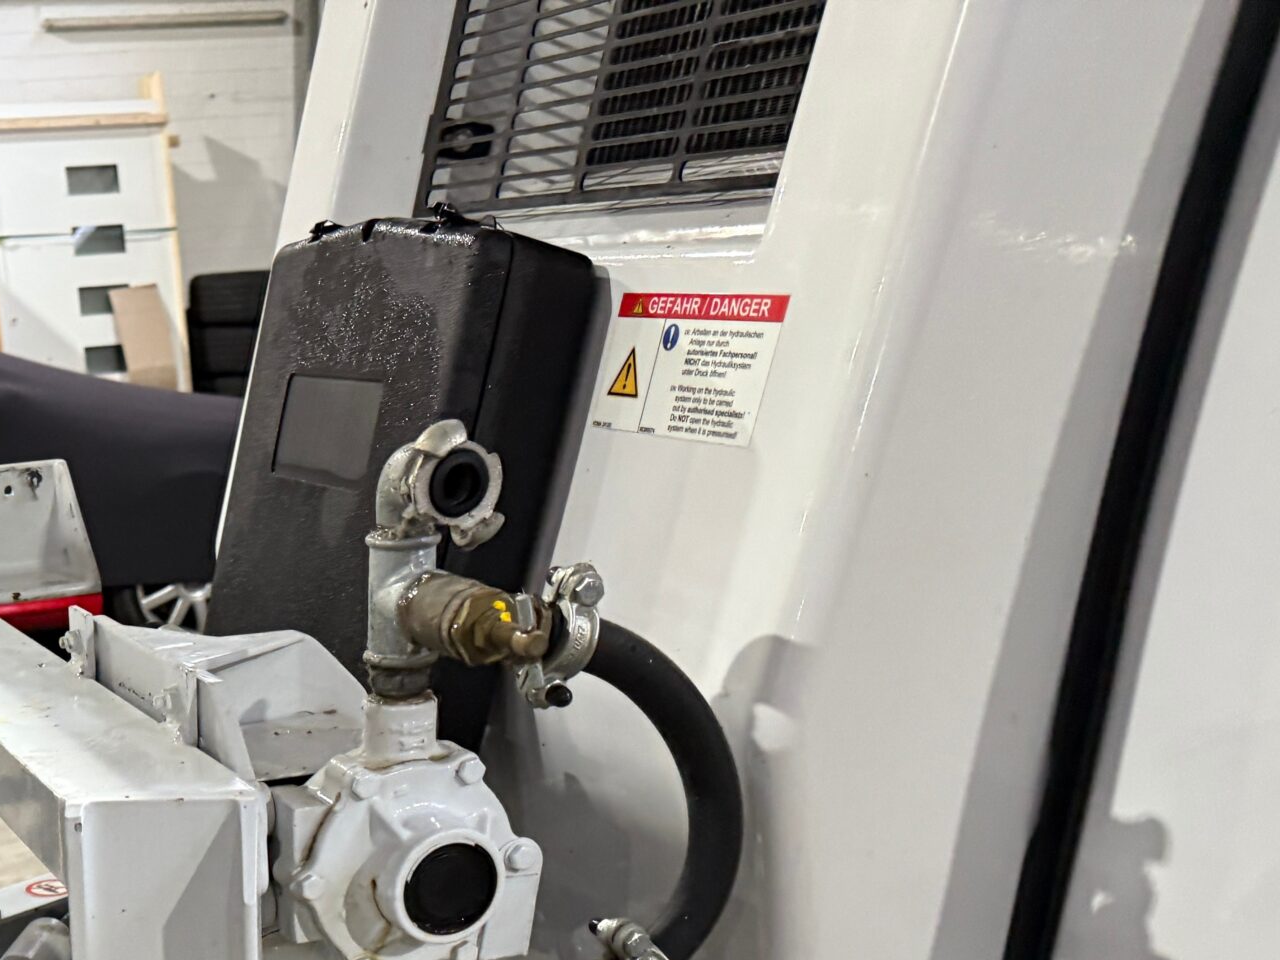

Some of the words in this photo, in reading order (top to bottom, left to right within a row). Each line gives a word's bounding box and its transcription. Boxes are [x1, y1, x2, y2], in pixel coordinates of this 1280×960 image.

[648, 297, 700, 316] GEFAHR
[701, 298, 709, 316] /
[710, 298, 771, 317] DANGER
[716, 339, 729, 347] durch
[684, 358, 700, 366] NICHT
[678, 385, 696, 395] Working
[704, 387, 712, 395] the
[713, 388, 735, 398] hydraulic
[692, 397, 702, 405] only
[681, 406, 687, 414] by
[678, 414, 689, 422] NOT
[702, 418, 710, 426] the
[711, 419, 733, 428] hydraulic
